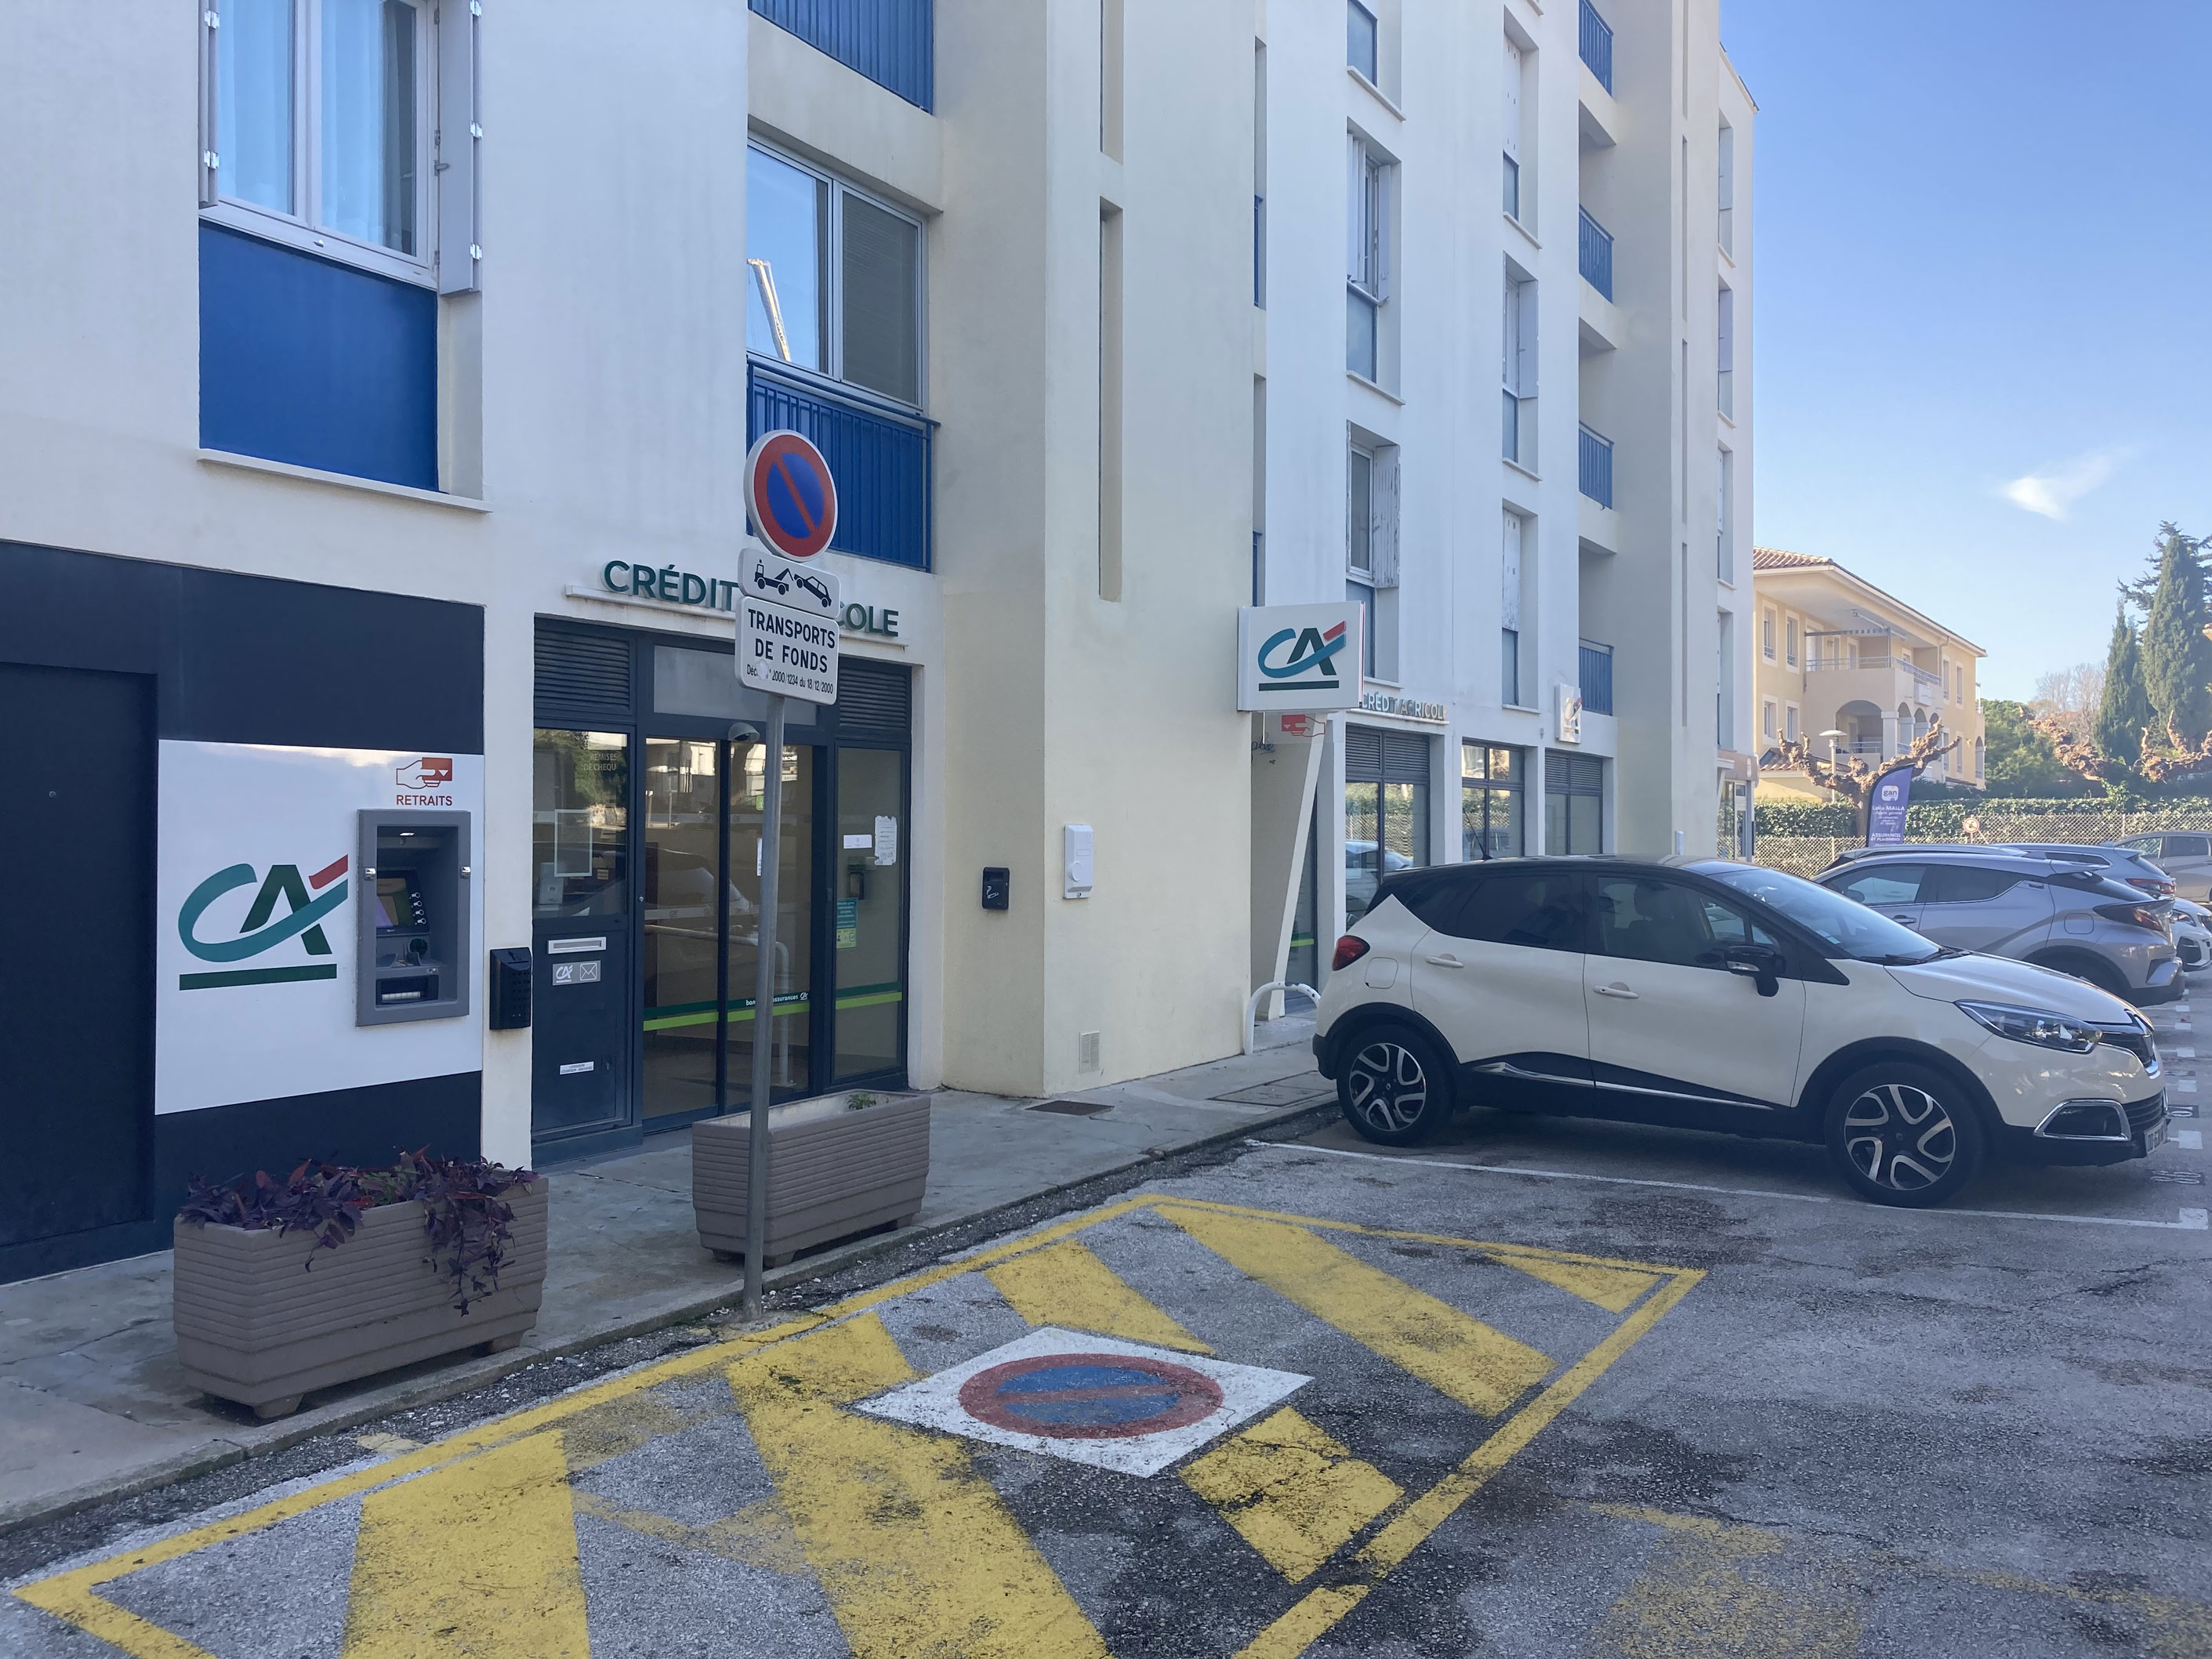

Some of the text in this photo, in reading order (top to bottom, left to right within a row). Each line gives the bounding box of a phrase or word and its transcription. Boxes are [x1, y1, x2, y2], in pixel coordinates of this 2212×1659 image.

[604, 560, 738, 611] CRÉDIT
[748, 608, 836, 650] TRANSPORTS
[755, 638, 828, 673] DE FONDS
[800, 677, 805, 688] du
[807, 679, 833, 694] 18/12/2000
[396, 794, 452, 806] RETRAITS
